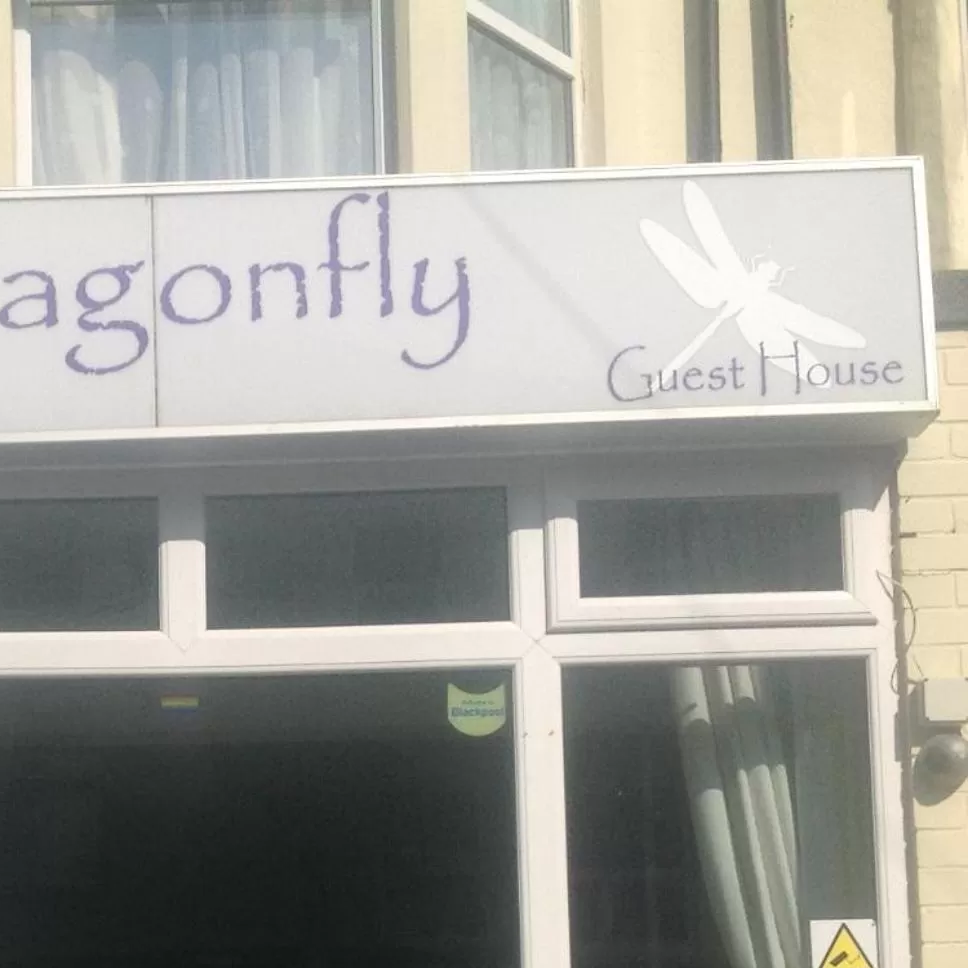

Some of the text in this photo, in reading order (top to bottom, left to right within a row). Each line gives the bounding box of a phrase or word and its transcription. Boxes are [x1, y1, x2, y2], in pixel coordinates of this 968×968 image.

[607, 339, 906, 402] Guest House
[451, 706, 505, 718] Blackpool
